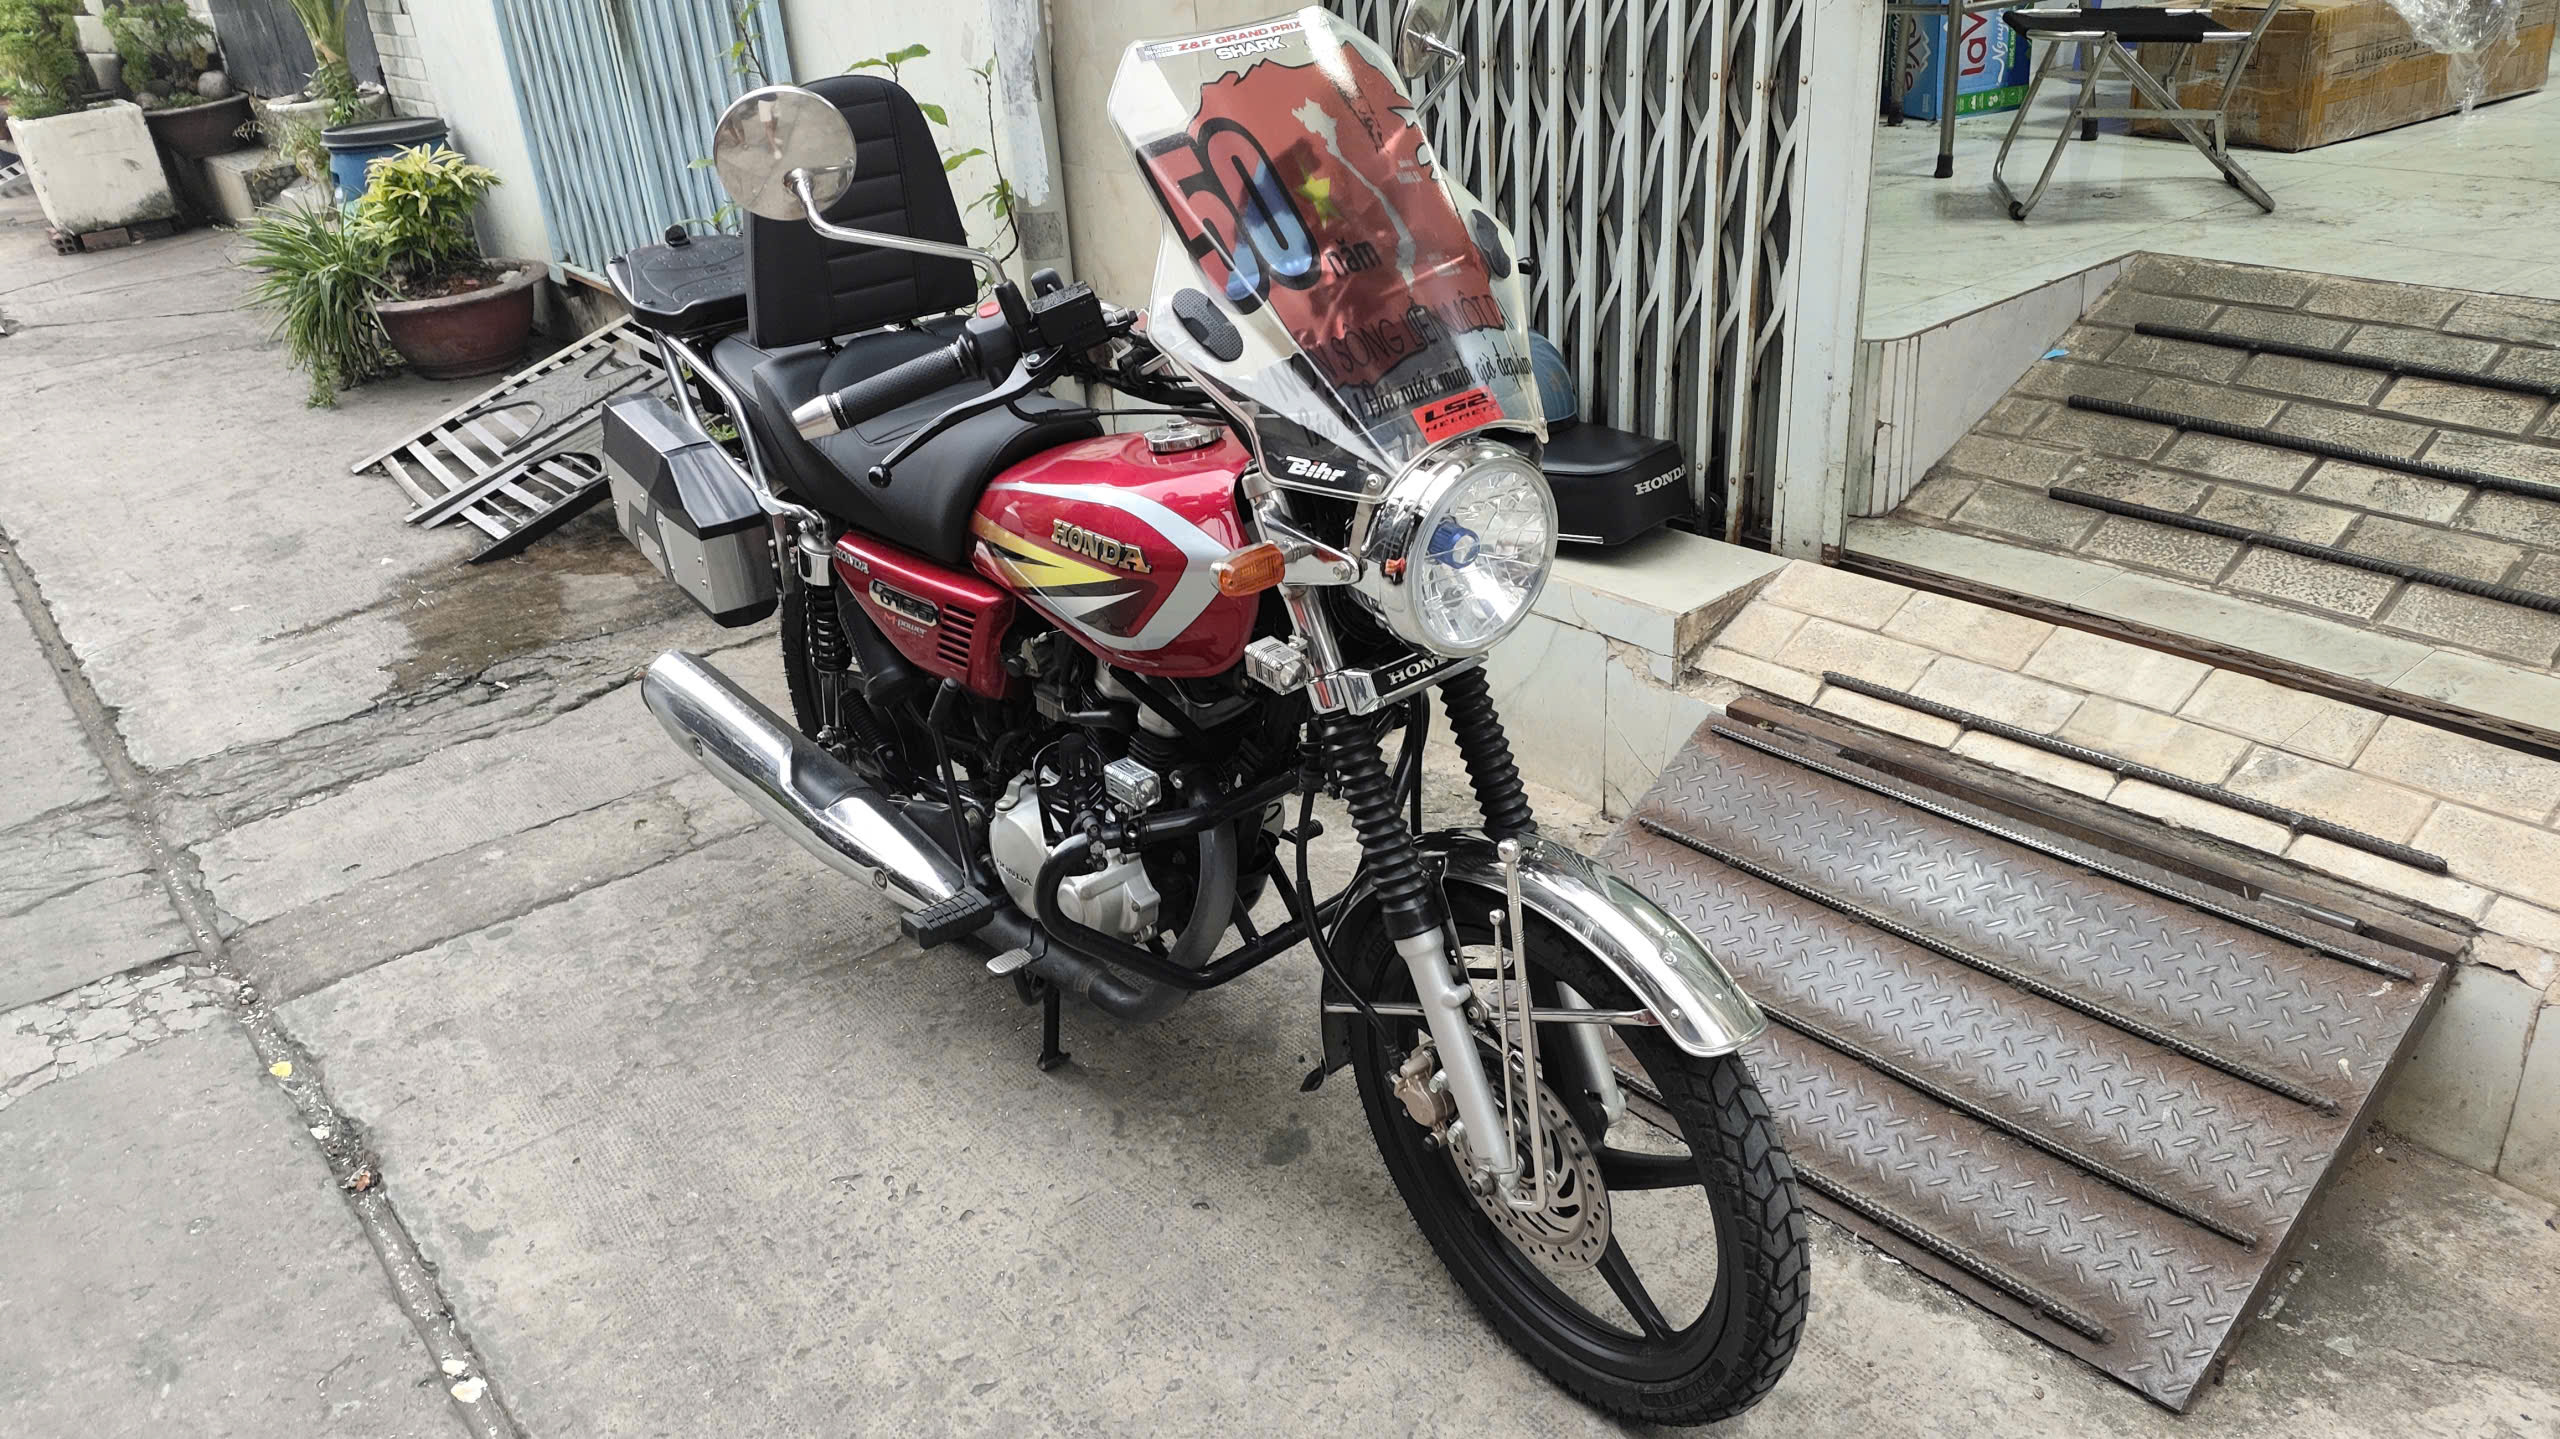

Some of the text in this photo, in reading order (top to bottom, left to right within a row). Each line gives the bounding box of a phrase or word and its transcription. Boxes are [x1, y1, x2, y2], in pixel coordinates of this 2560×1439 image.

[1177, 20, 1302, 51] Z&F GRAND PRIX
[1215, 35, 1288, 61] SHARK
[1136, 117, 1321, 315] 50
[1325, 237, 1382, 279] năm
[1330, 319, 1406, 374] SÔNG
[1439, 349, 1476, 392] mình
[1425, 392, 1488, 422] LS2
[1426, 403, 1497, 433] HELMETS
[1285, 455, 1346, 482] Bihr
[1050, 518, 1152, 574] HONDA
[1386, 656, 1448, 686] HON
